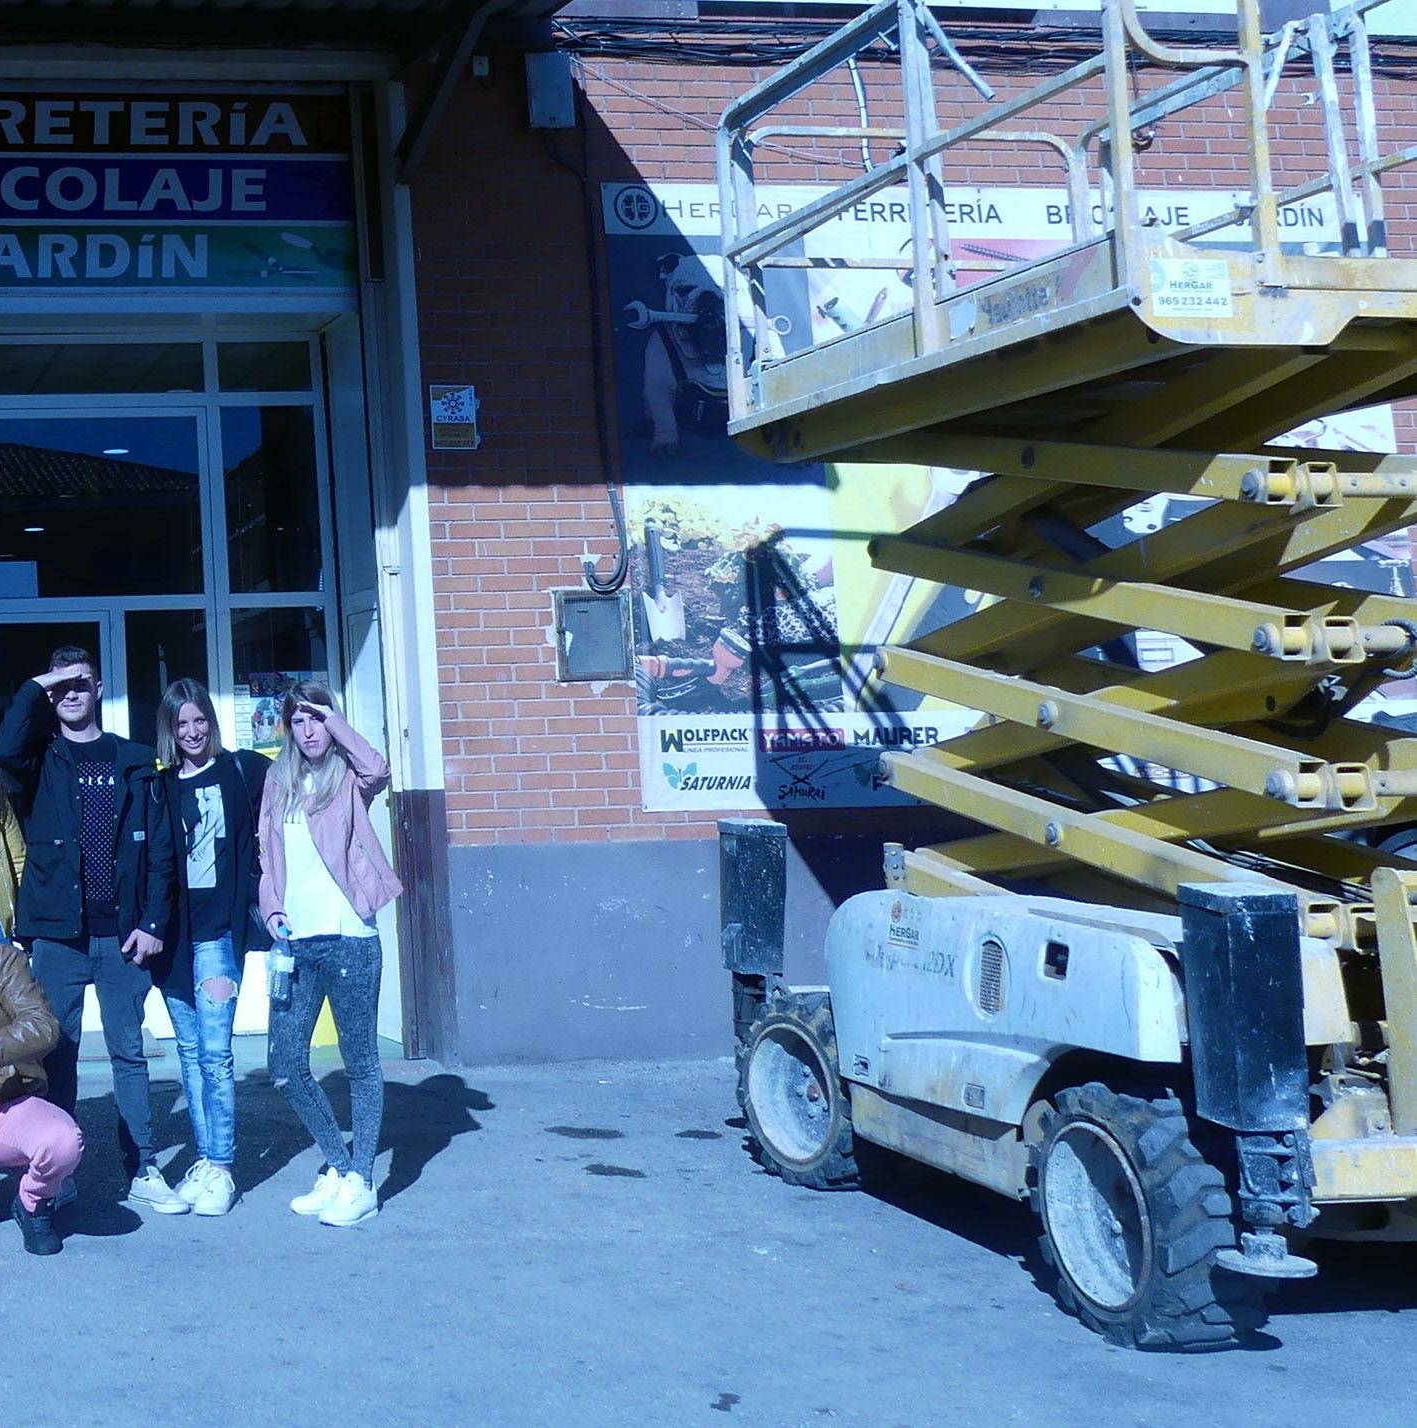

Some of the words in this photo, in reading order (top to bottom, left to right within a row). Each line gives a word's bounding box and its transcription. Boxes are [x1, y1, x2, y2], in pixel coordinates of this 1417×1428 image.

[1157, 296, 1180, 306] 969
[1181, 296, 1204, 306] 232
[1205, 296, 1229, 306] 442
[660, 728, 749, 753] WOLFPACK
[763, 732, 841, 749] YAMATO
[853, 726, 939, 746] MAURER
[680, 775, 752, 791] SATURNIA
